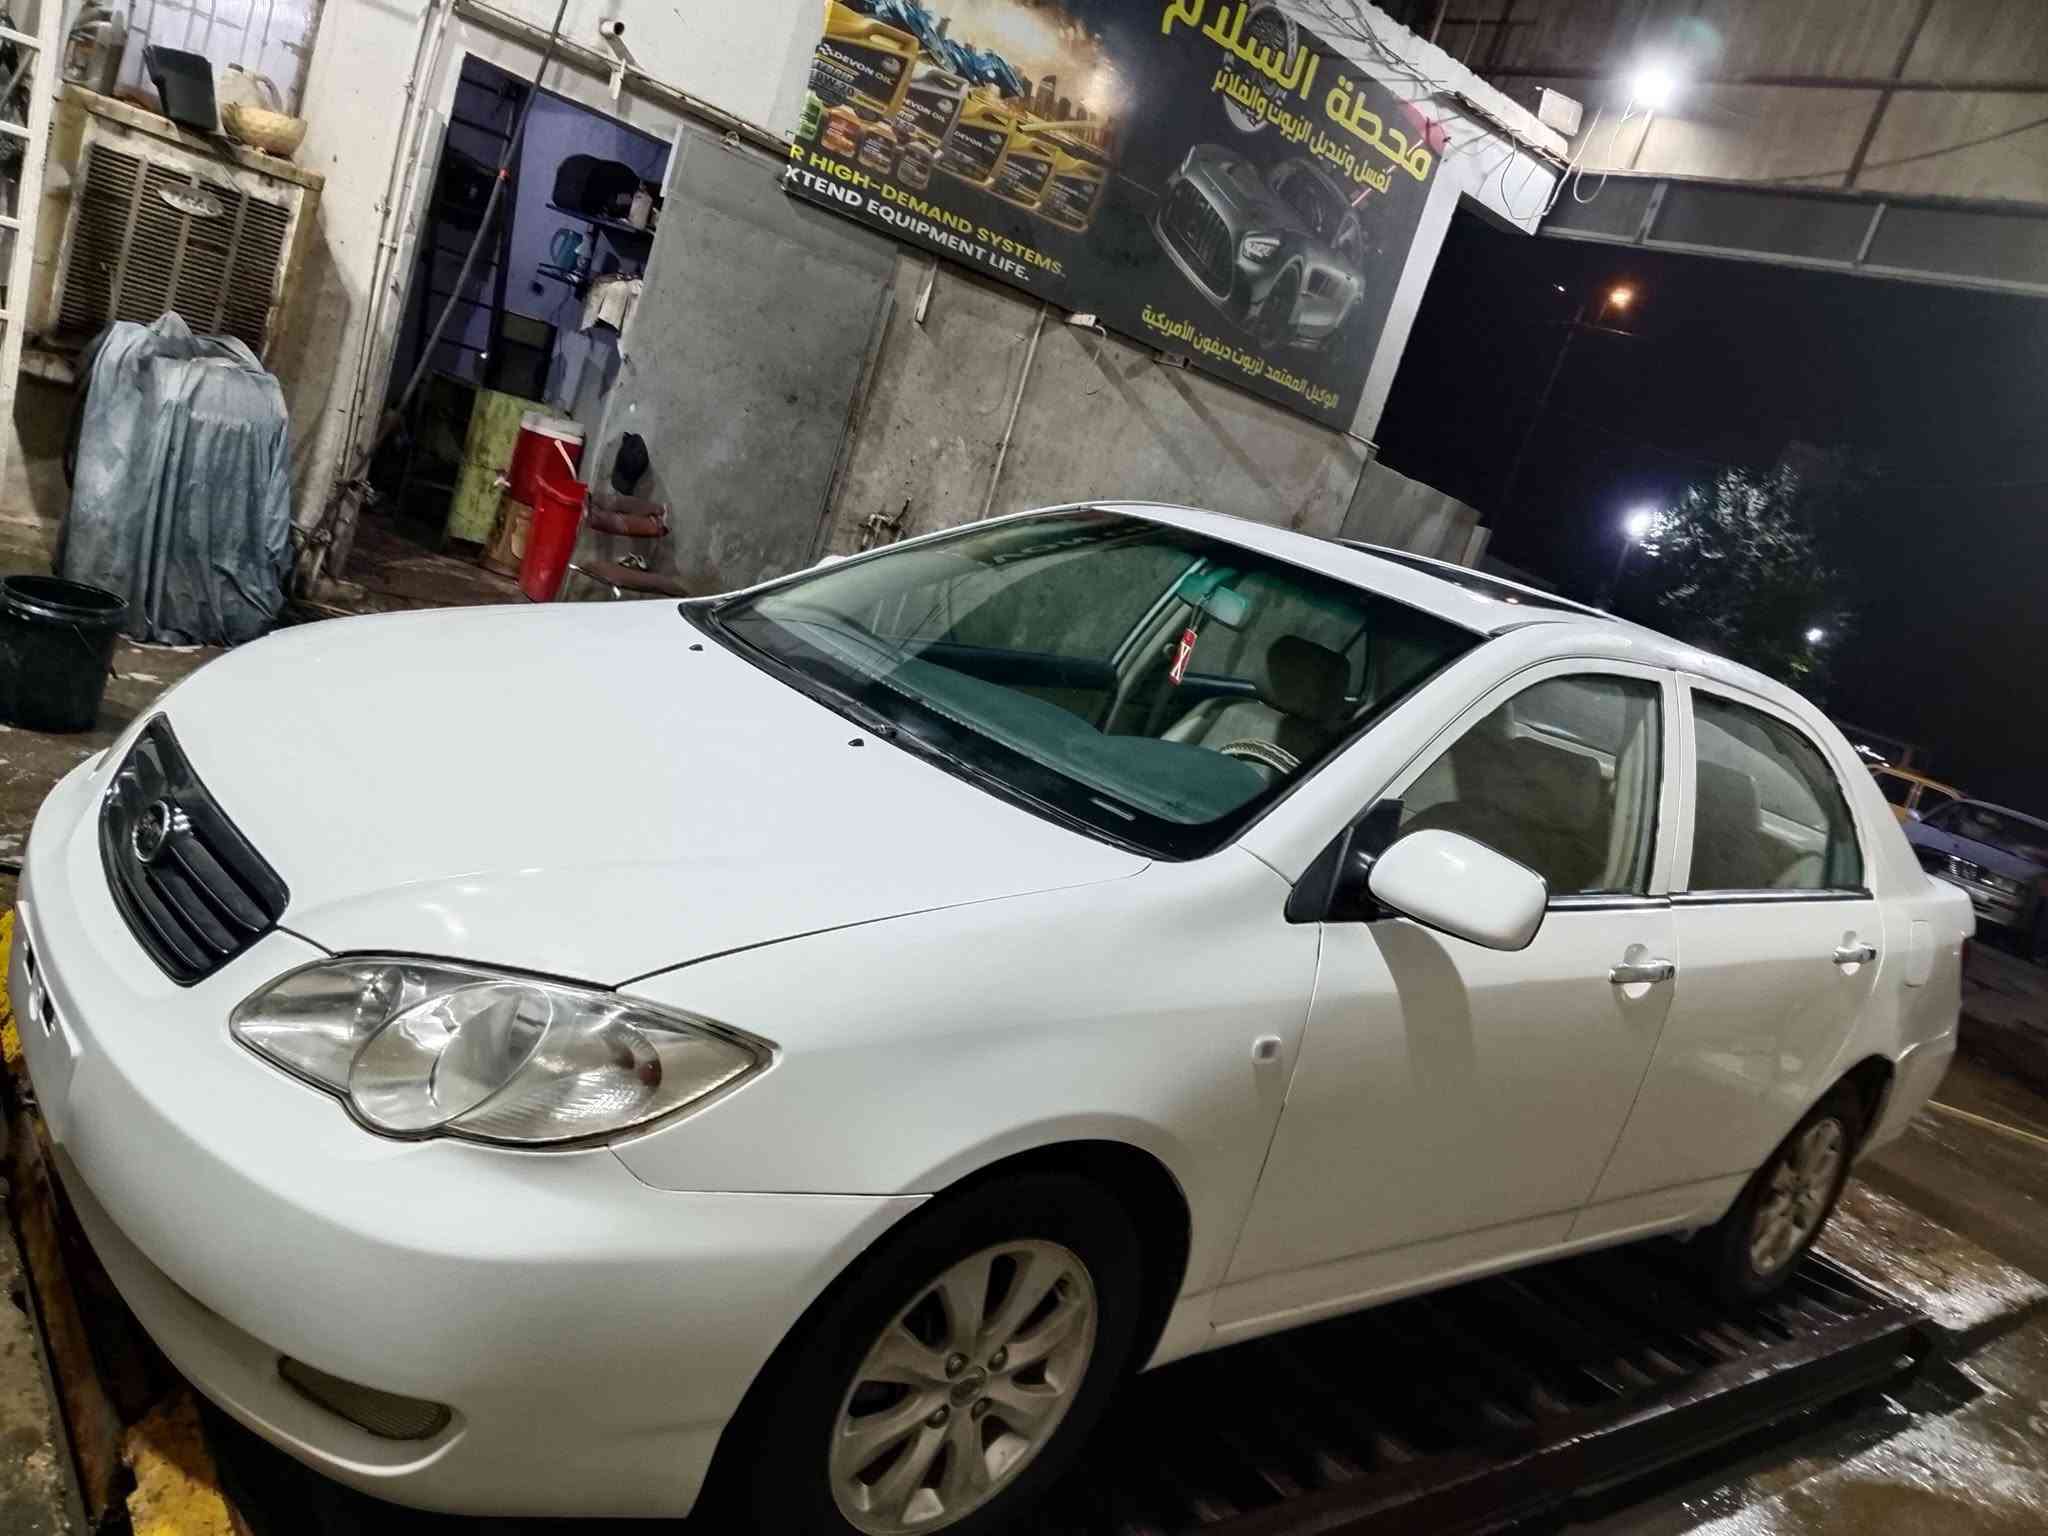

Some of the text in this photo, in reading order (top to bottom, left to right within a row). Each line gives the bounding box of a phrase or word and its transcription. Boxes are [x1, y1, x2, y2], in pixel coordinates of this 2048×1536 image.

[834, 50, 875, 77] DEVON
[1161, 0, 1320, 100] السلام
[1210, 66, 1269, 121] والفلاتر
[1266, 98, 1313, 145] الزيوت
[1325, 75, 1432, 183] محطة
[1309, 130, 1355, 177] وتبديل
[808, 151, 973, 234] HIGH-DEMAND
[976, 227, 1067, 279] SYSTEMS.
[866, 198, 987, 261] EQUIPMENT
[988, 252, 1031, 281] LIFE.
[1193, 332, 1232, 361] ديفون
[1231, 347, 1264, 377] لزيوت
[1264, 365, 1308, 396] المعتمد
[1306, 383, 1339, 409] الوكيل
